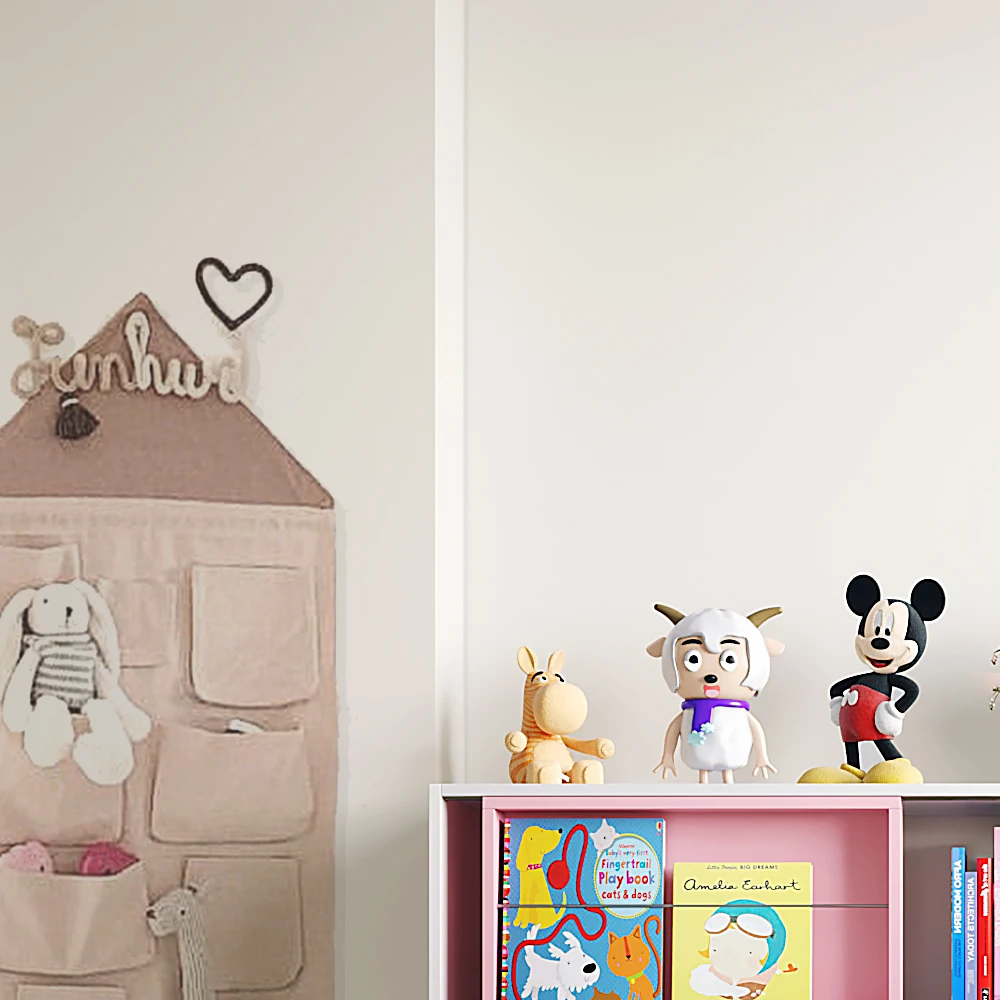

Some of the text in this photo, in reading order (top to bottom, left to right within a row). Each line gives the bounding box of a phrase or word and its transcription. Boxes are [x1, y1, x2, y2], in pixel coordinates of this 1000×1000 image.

[601, 858, 652, 871] Fingertrail
[683, 878, 801, 891] Amelia Earhart
[601, 888, 652, 901] cats & dogs
